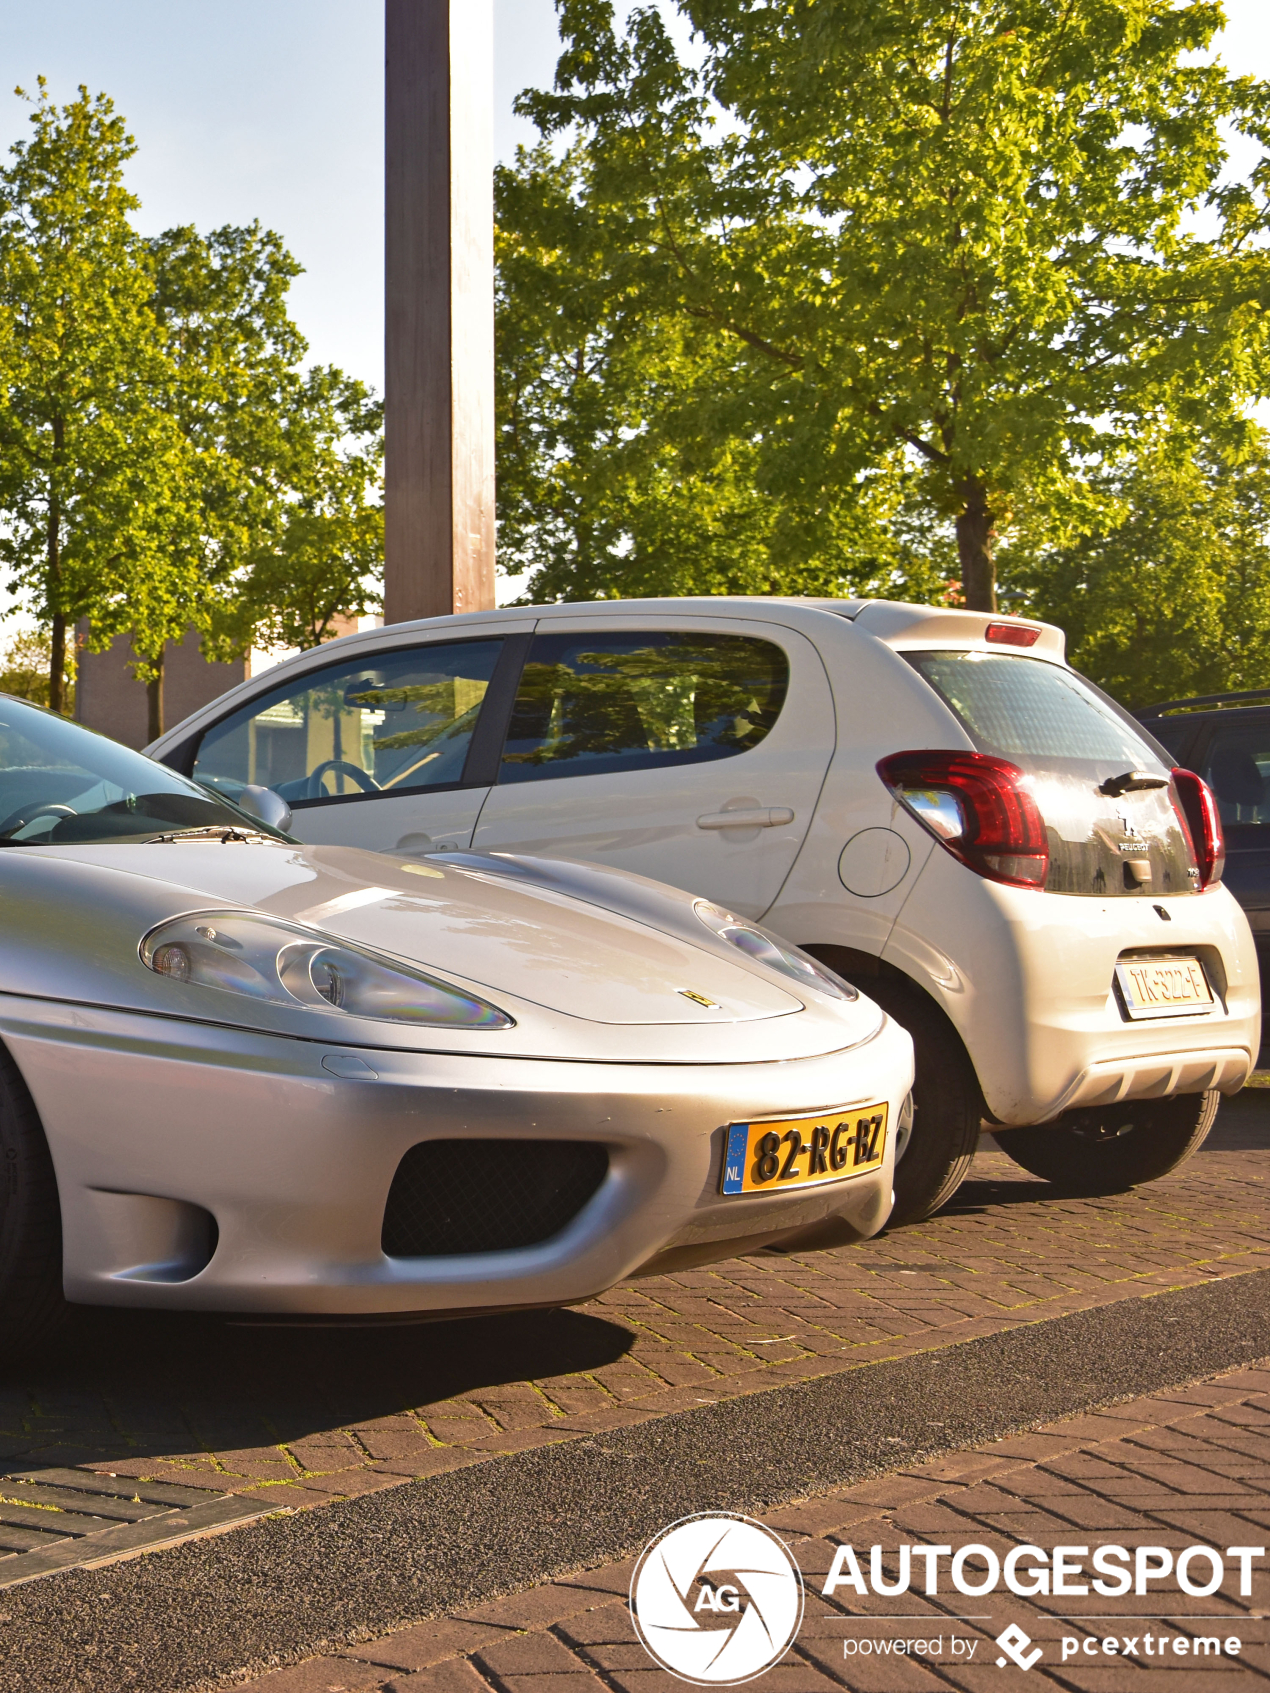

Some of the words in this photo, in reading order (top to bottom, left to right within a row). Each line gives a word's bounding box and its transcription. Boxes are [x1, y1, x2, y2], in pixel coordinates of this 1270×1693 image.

[1130, 965, 1200, 1002] TK-322-F
[758, 1114, 883, 1182] 82-RG-BZ
[726, 1166, 740, 1181] NL
